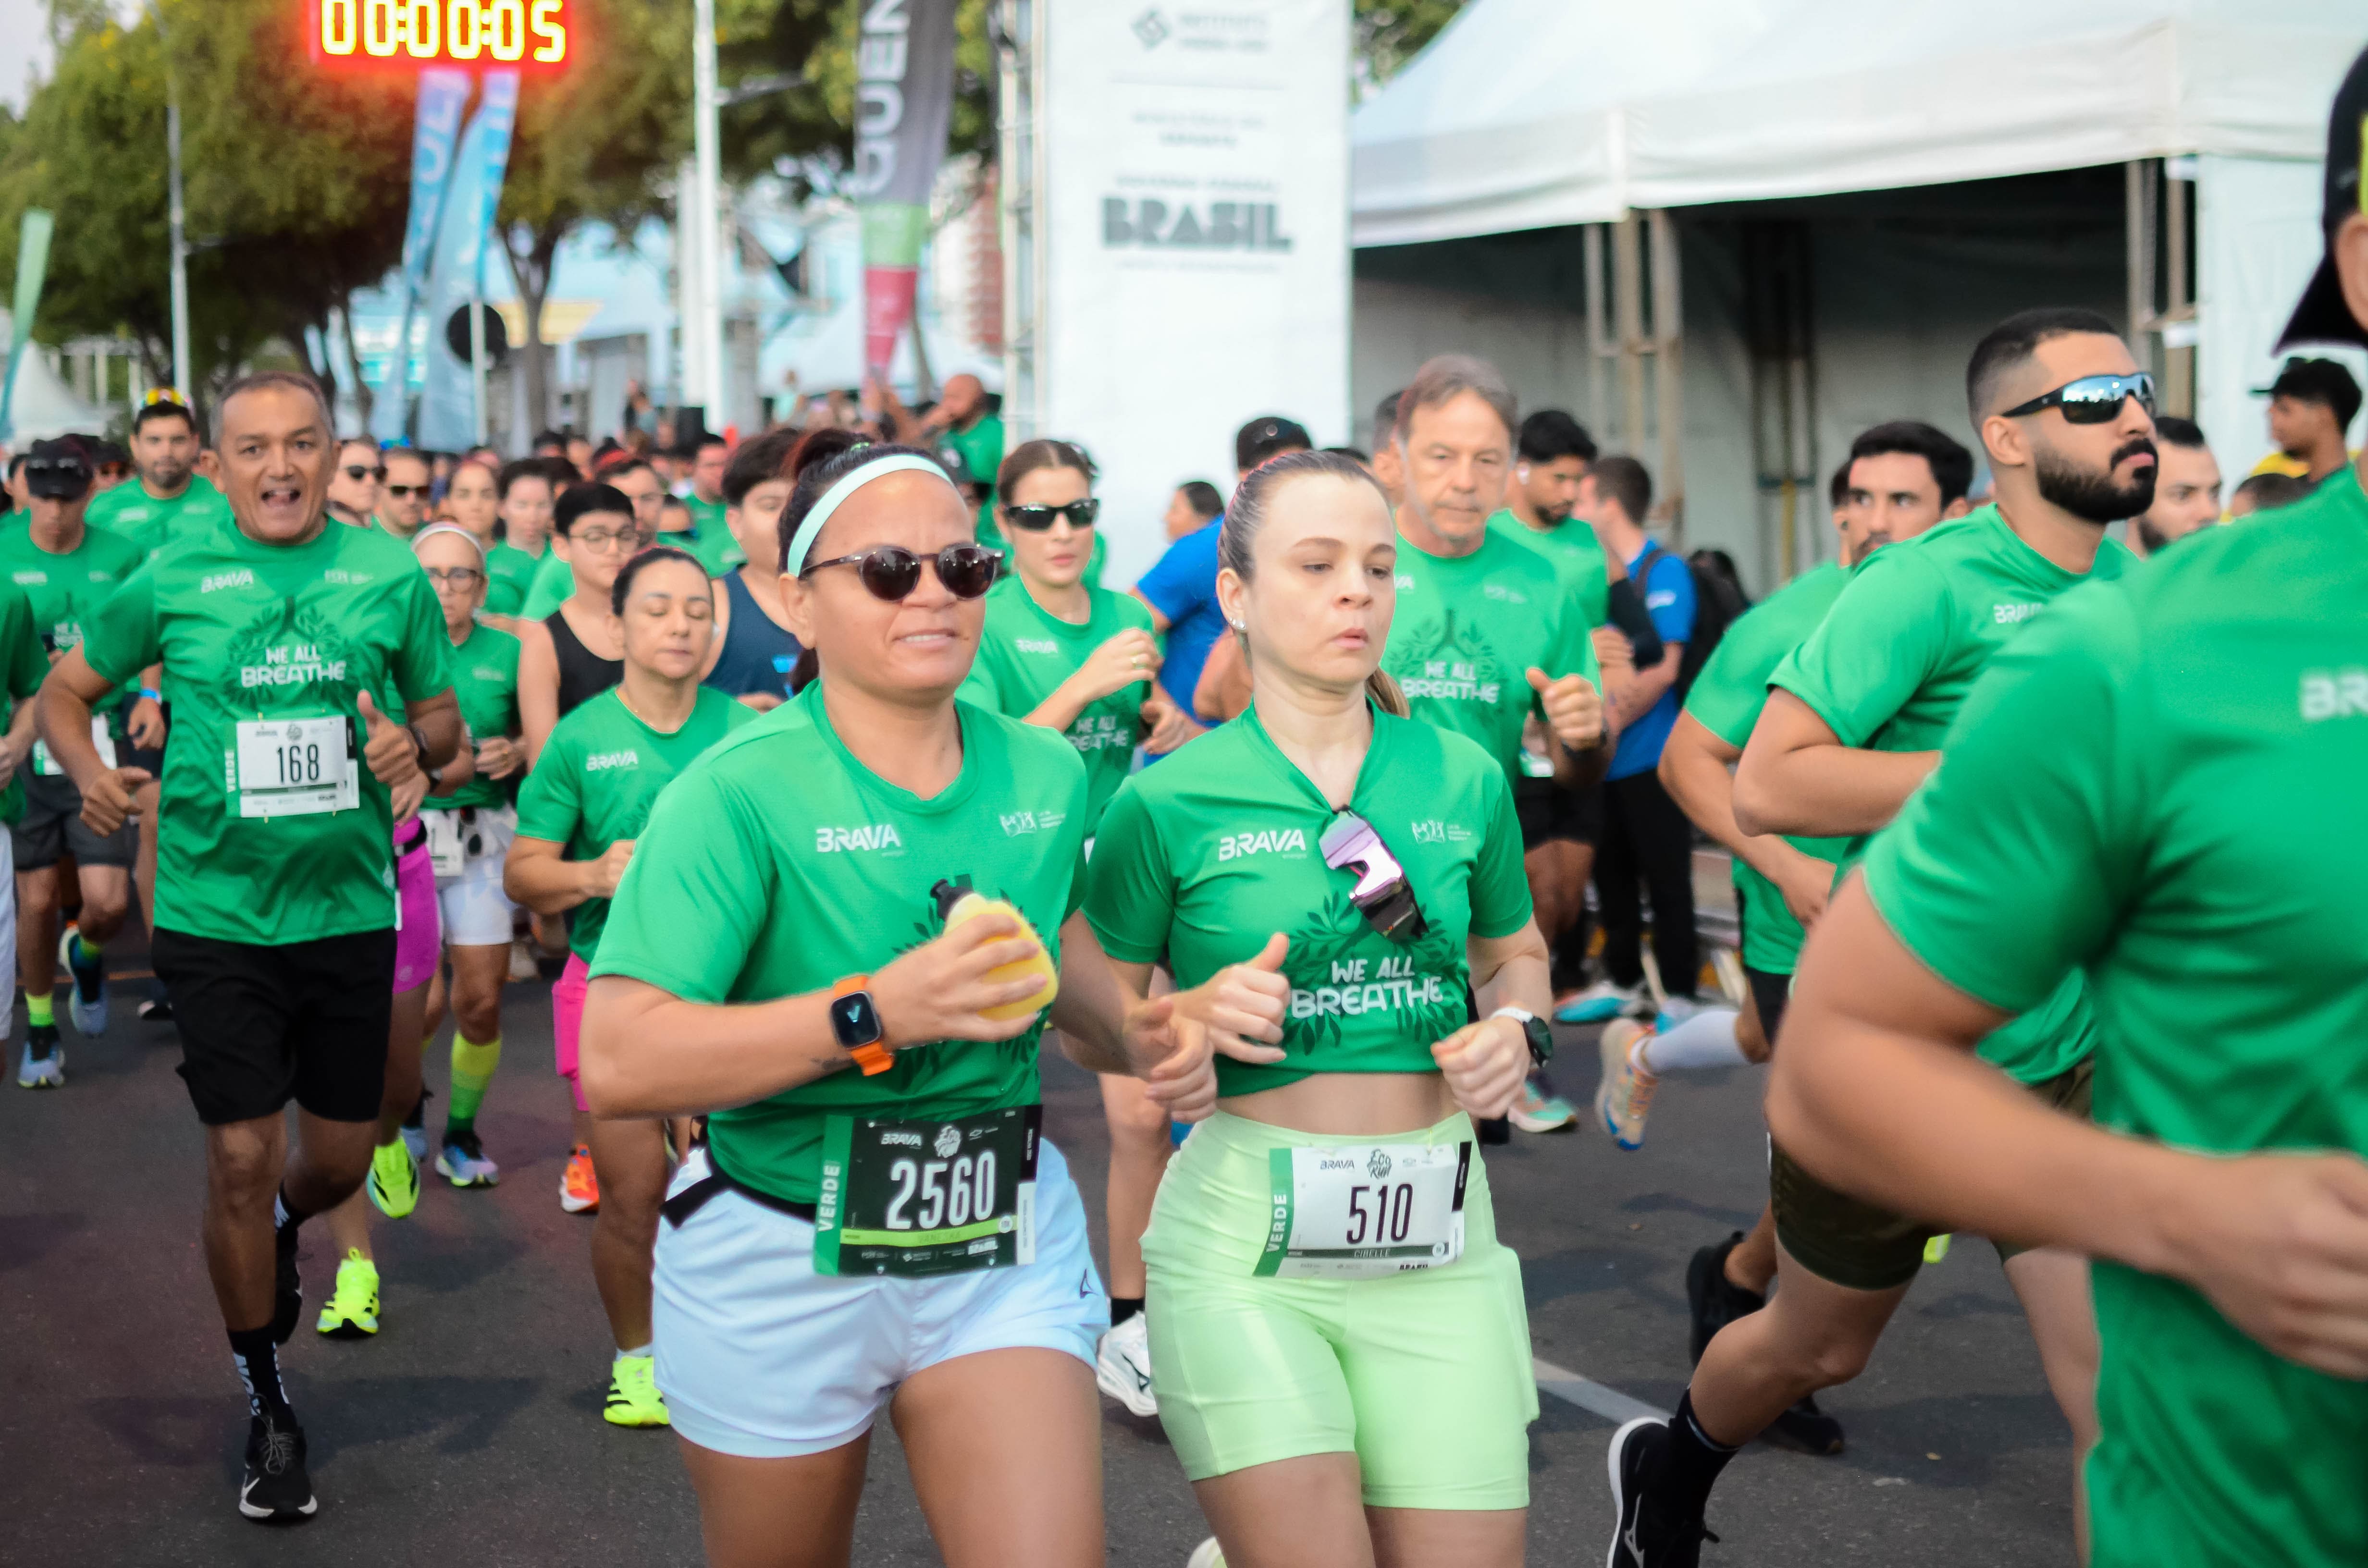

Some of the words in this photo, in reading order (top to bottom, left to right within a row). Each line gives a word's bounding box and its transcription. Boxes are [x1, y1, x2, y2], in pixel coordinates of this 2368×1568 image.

[321, 0, 566, 62] 00:00:05
[1100, 196, 1295, 254] BRASIL
[201, 569, 254, 593] BRAVA
[266, 648, 288, 665] WE
[294, 645, 321, 662] ALL
[241, 661, 347, 687] BREATHE
[1425, 661, 1446, 678] WE
[1451, 662, 1477, 681] ALL
[1401, 678, 1500, 703] BREATHE
[277, 744, 320, 784] 168
[586, 750, 639, 772] BRAVA
[816, 824, 900, 853] BRAVA
[1219, 829, 1307, 861] BRAVA
[1332, 959, 1368, 983] WE
[1376, 956, 1415, 978] ALL
[1291, 976, 1443, 1019] BREATHE
[881, 1133, 922, 1146] BRAVA
[1320, 1160, 1355, 1170] BRAVA
[817, 1165, 841, 1232] VERDE
[886, 1149, 997, 1230] 2560
[1266, 1193, 1287, 1253] VERDE
[1346, 1183, 1413, 1245] 510
